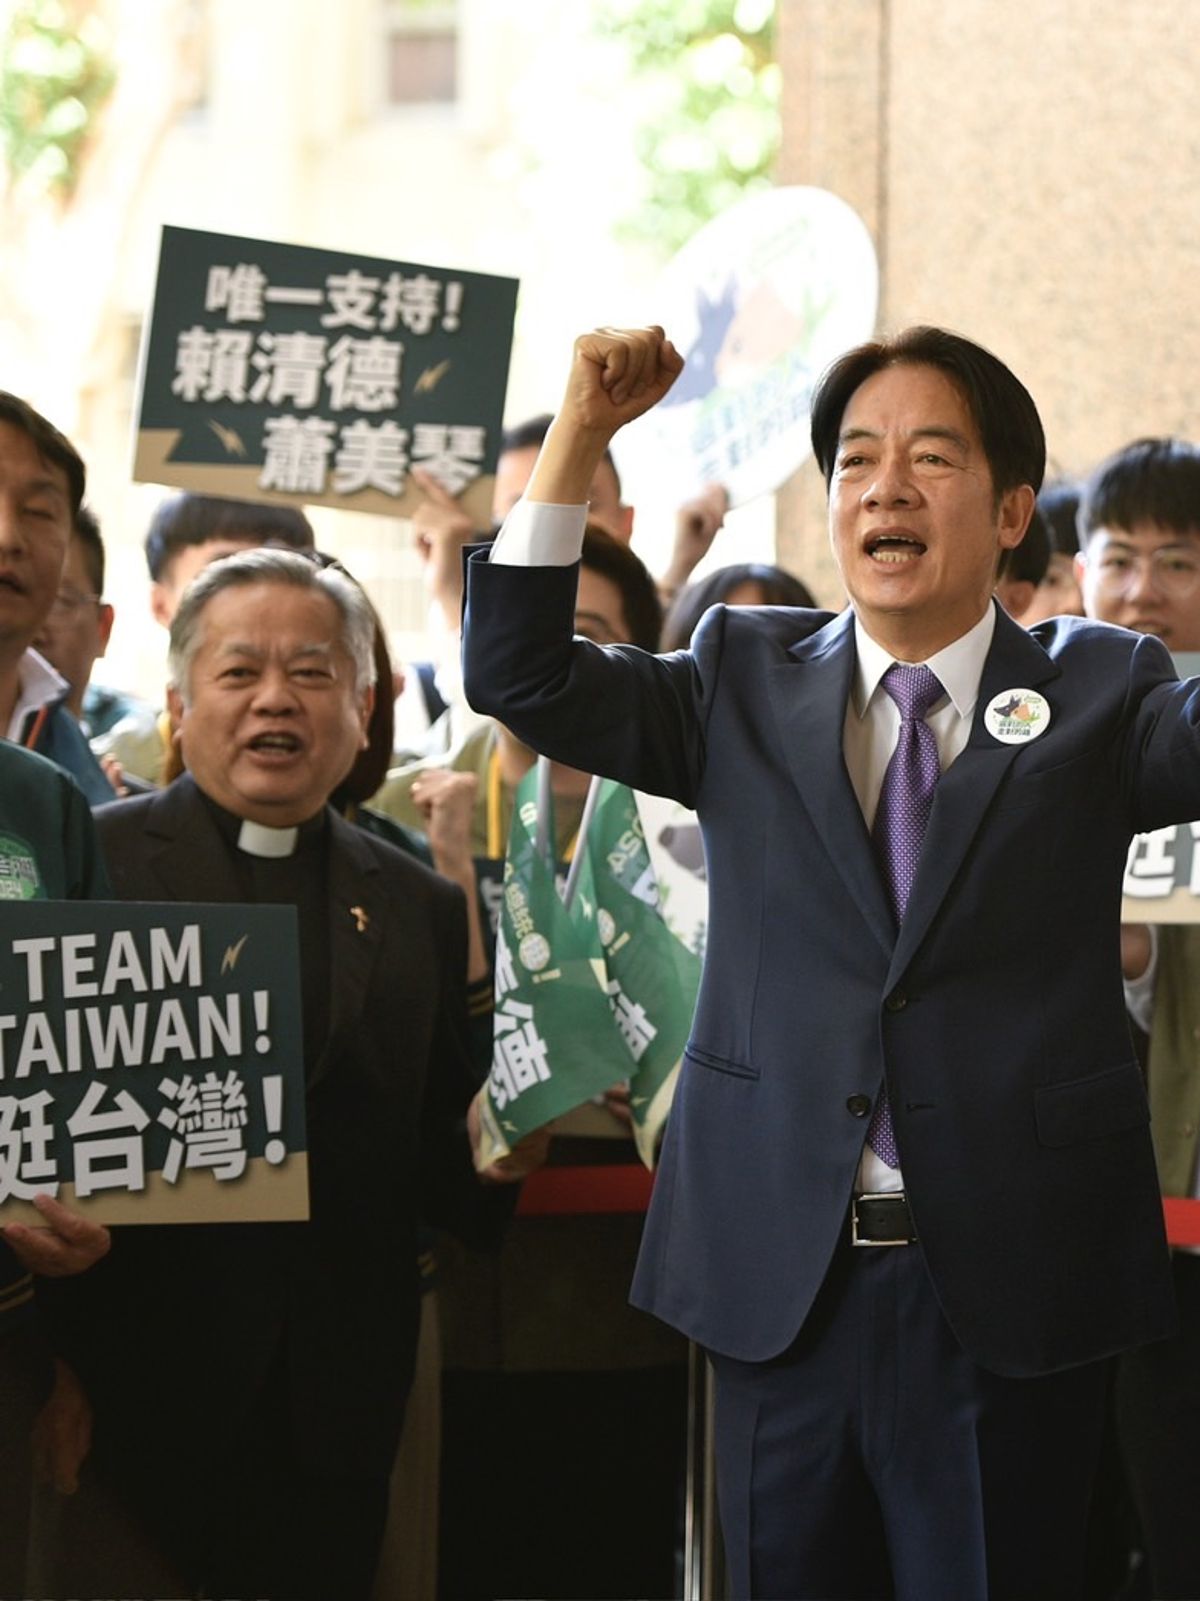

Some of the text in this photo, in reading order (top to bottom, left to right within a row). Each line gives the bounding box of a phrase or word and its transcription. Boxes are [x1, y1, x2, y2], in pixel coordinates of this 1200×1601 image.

[204, 262, 464, 335] 唯一支持!
[171, 326, 404, 412] 賴清德
[259, 416, 486, 498] 蕭美琴
[12, 924, 203, 1002] TEAM
